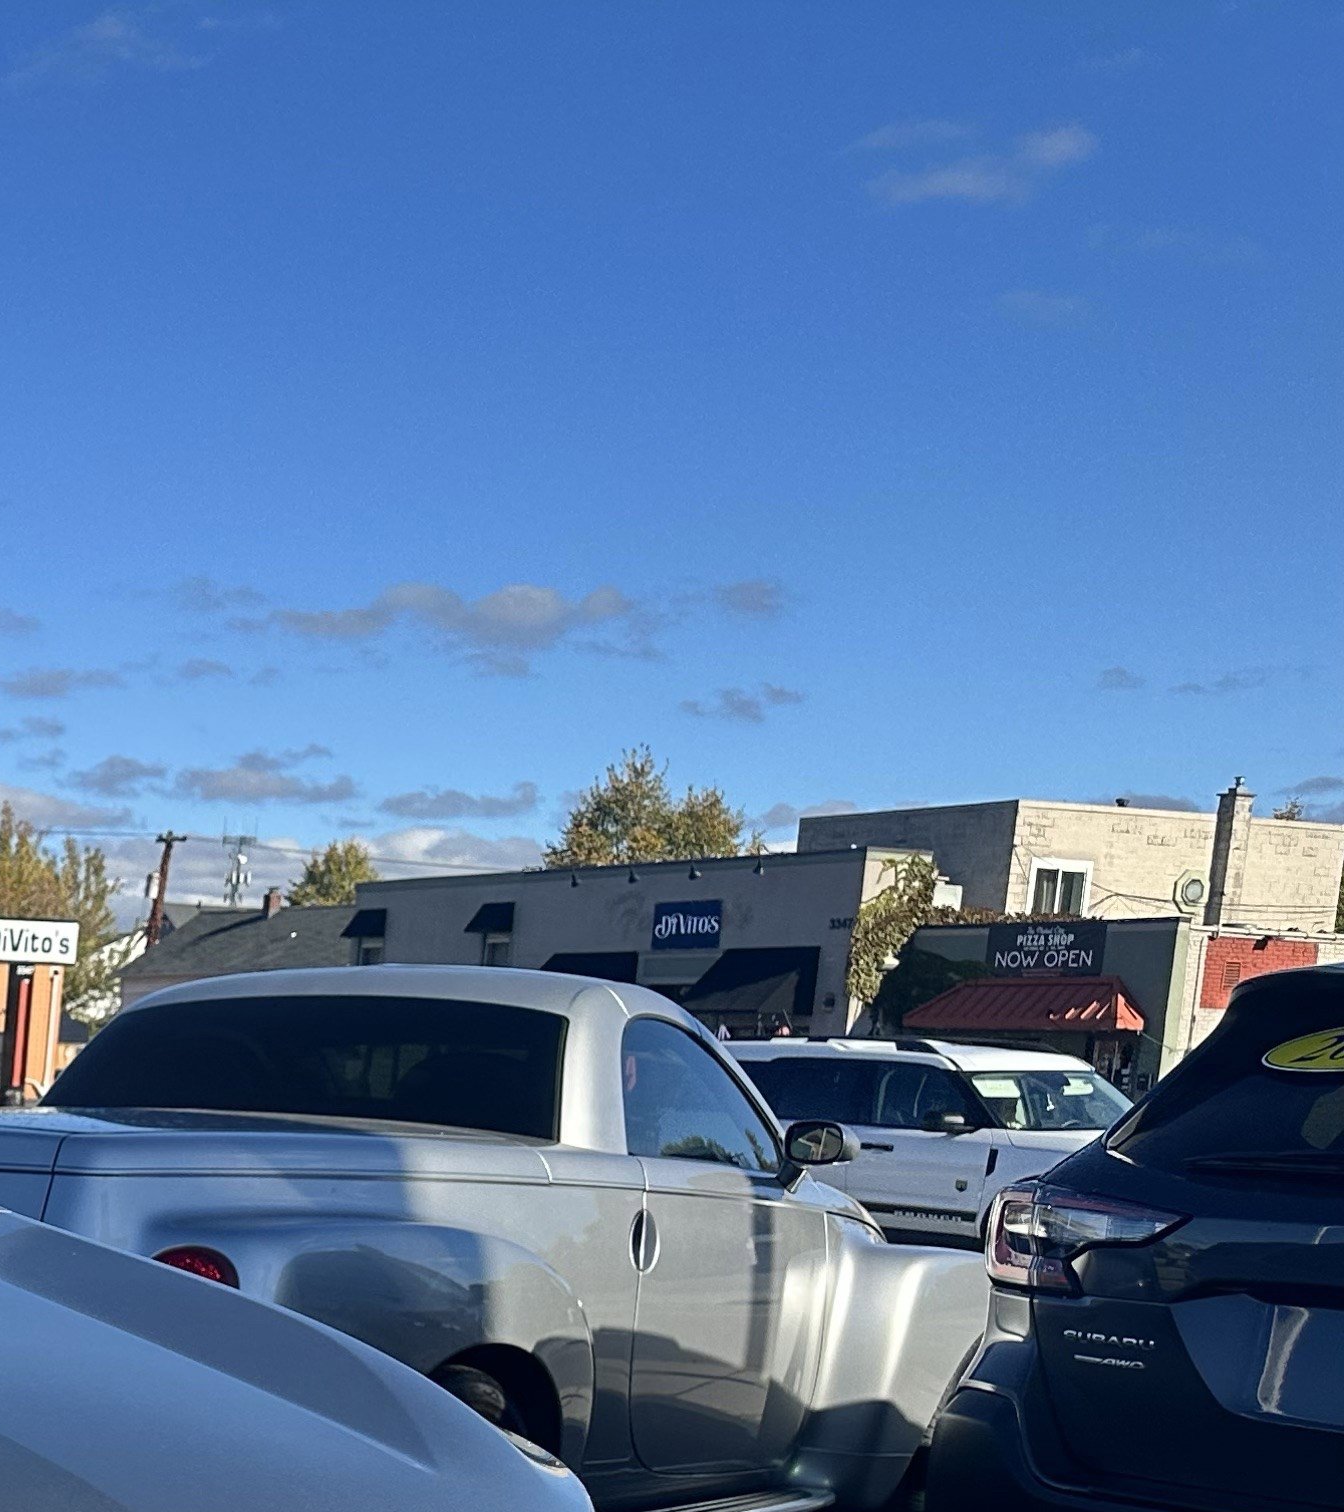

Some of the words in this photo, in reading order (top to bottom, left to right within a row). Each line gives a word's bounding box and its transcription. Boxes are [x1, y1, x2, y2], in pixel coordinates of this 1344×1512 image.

[1016, 934, 1045, 946] PIZZA
[1047, 933, 1075, 946] SHOP
[994, 950, 1040, 968] NOW
[1044, 949, 1093, 968] OPEN
[1063, 1329, 1155, 1350] SUBARU
